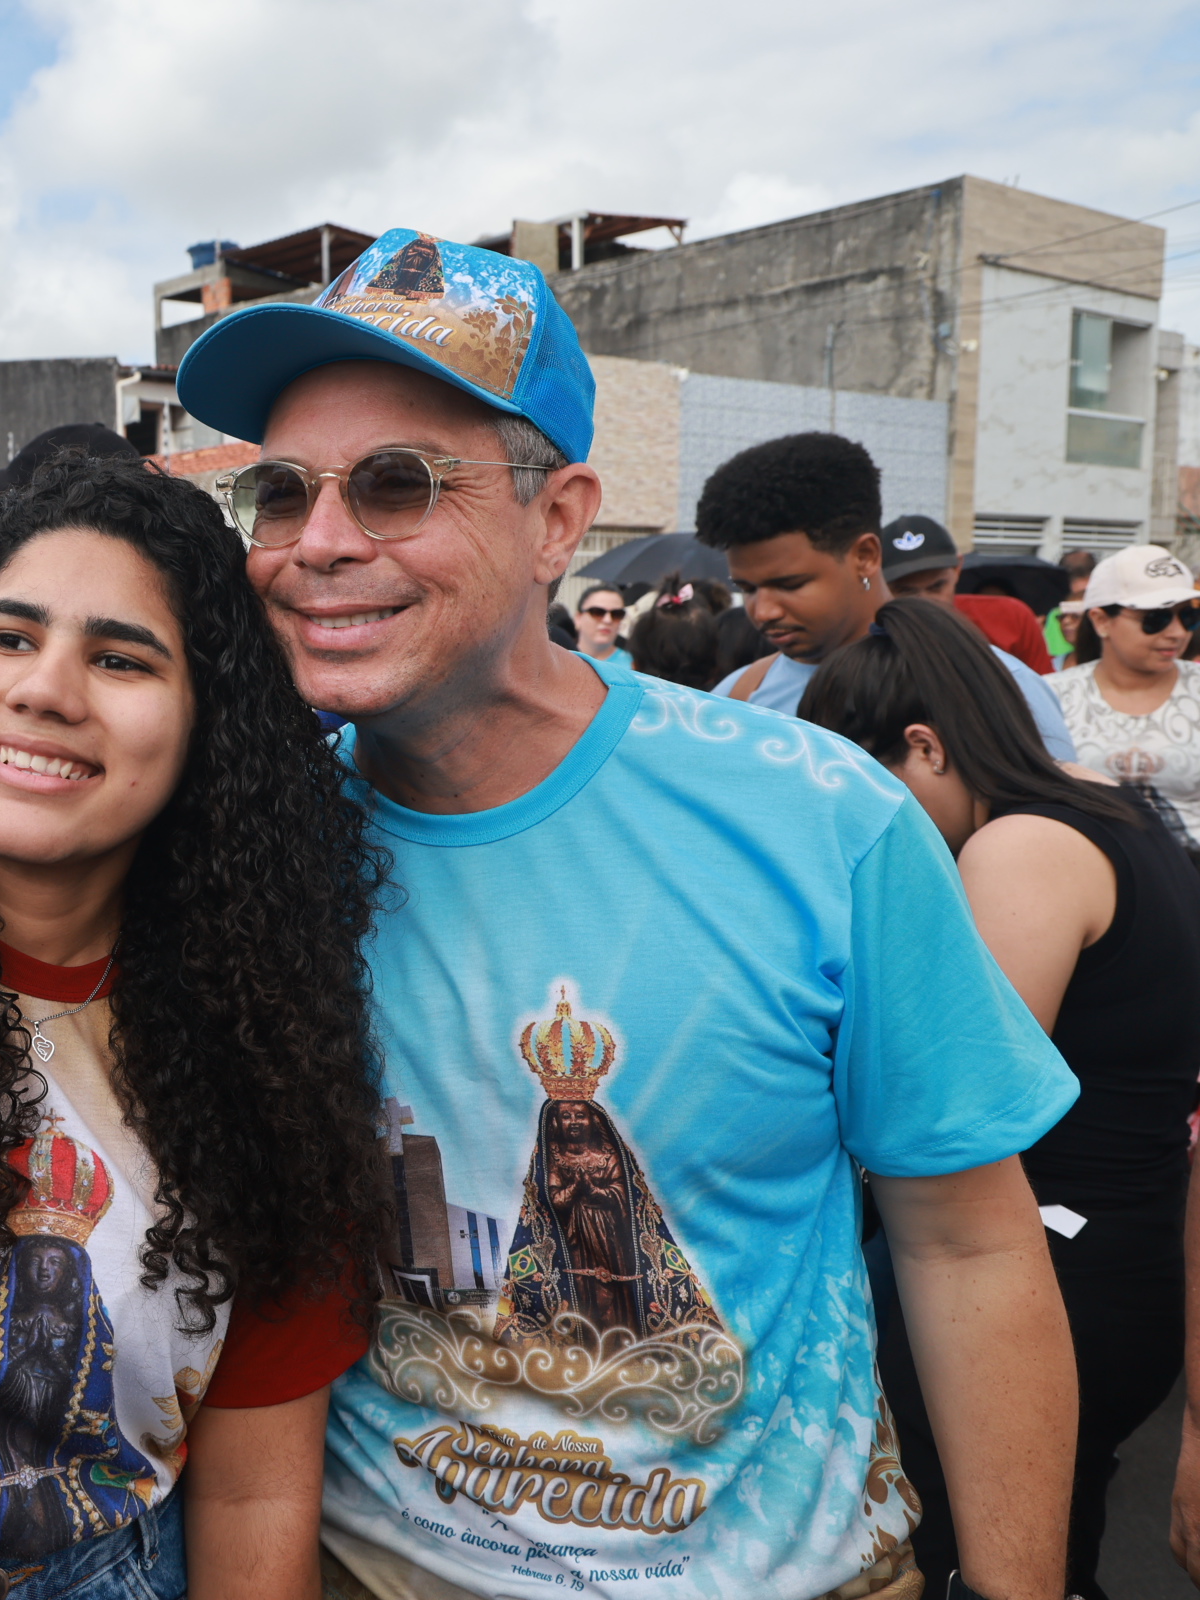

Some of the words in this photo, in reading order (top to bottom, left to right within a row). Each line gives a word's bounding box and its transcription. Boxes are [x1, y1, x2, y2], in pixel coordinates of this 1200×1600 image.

[451, 1422, 608, 1480] Senhora
[532, 1436, 548, 1450] de
[552, 1434, 598, 1453] Nossa
[396, 1430, 704, 1529] Aparecida
[401, 1507, 410, 1520] é
[413, 1515, 457, 1538] como
[460, 1527, 522, 1556] âncora
[589, 1568, 640, 1583] nossa
[511, 1564, 553, 1583] Hebreus
[570, 1578, 586, 1592] 19
